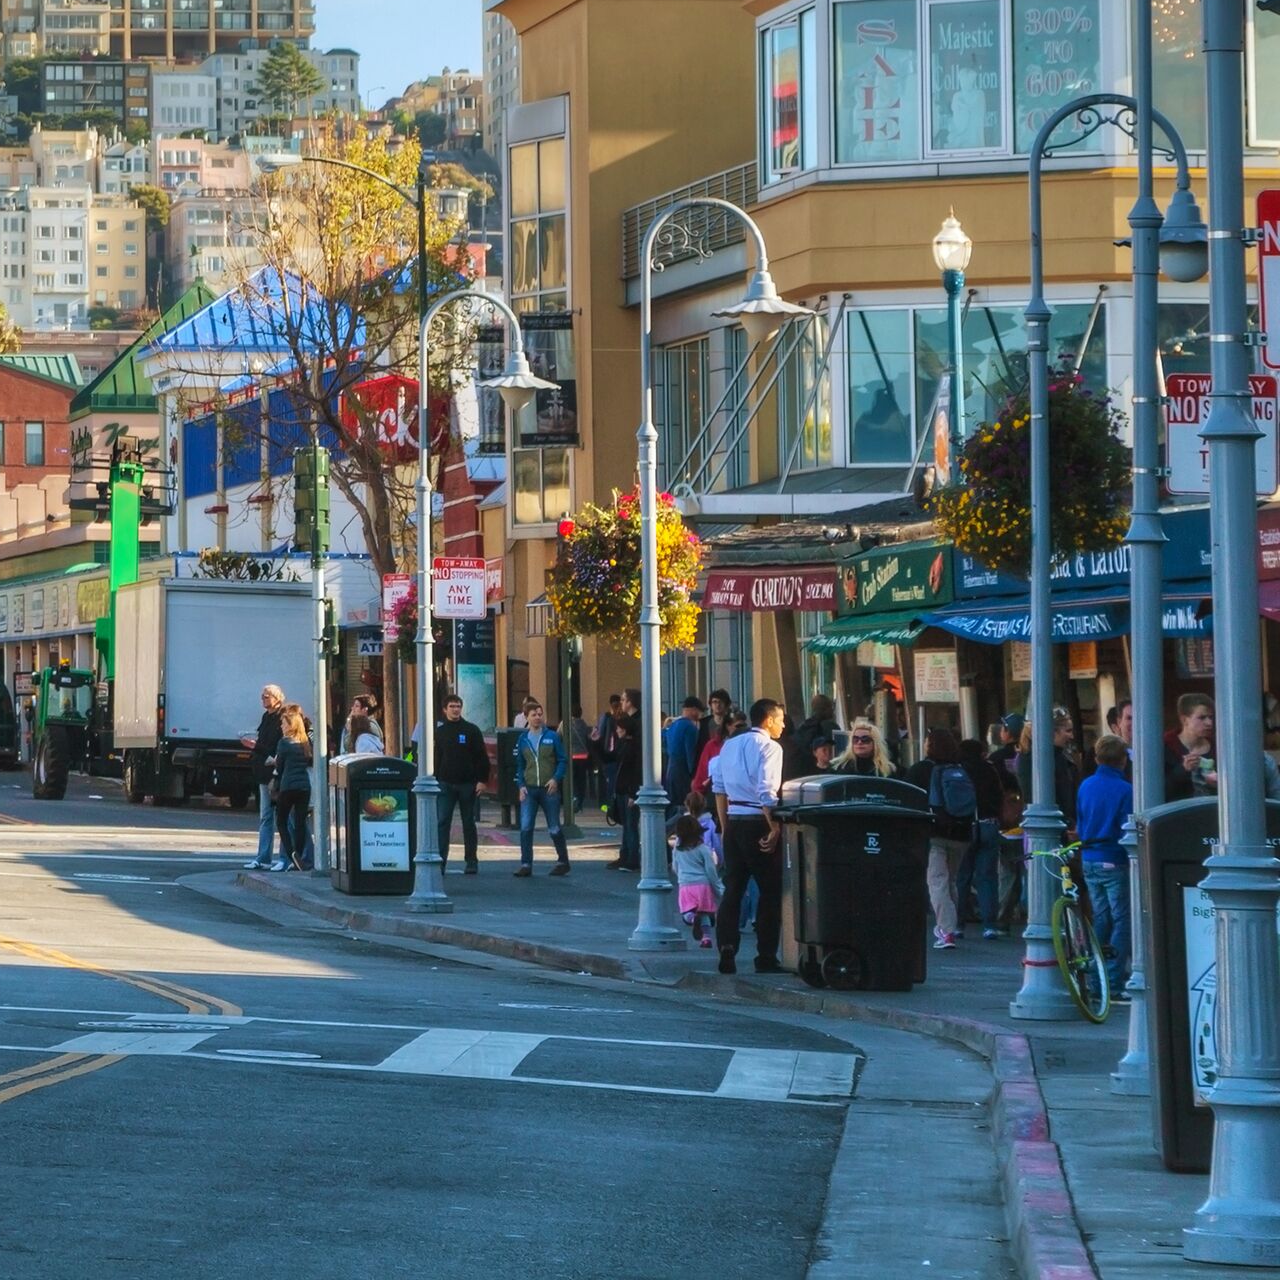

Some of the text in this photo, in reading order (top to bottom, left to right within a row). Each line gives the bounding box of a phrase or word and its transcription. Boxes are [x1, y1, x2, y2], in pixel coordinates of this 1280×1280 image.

[1024, 6, 1092, 36] 30%
[939, 22, 994, 55] Majestic
[1044, 40, 1073, 64] TO
[1026, 64, 1093, 96] 60%
[1170, 396, 1196, 422] NO
[434, 568, 484, 579] NO STOPPING
[447, 596, 472, 605] TIME
[449, 585, 471, 594] ANY
